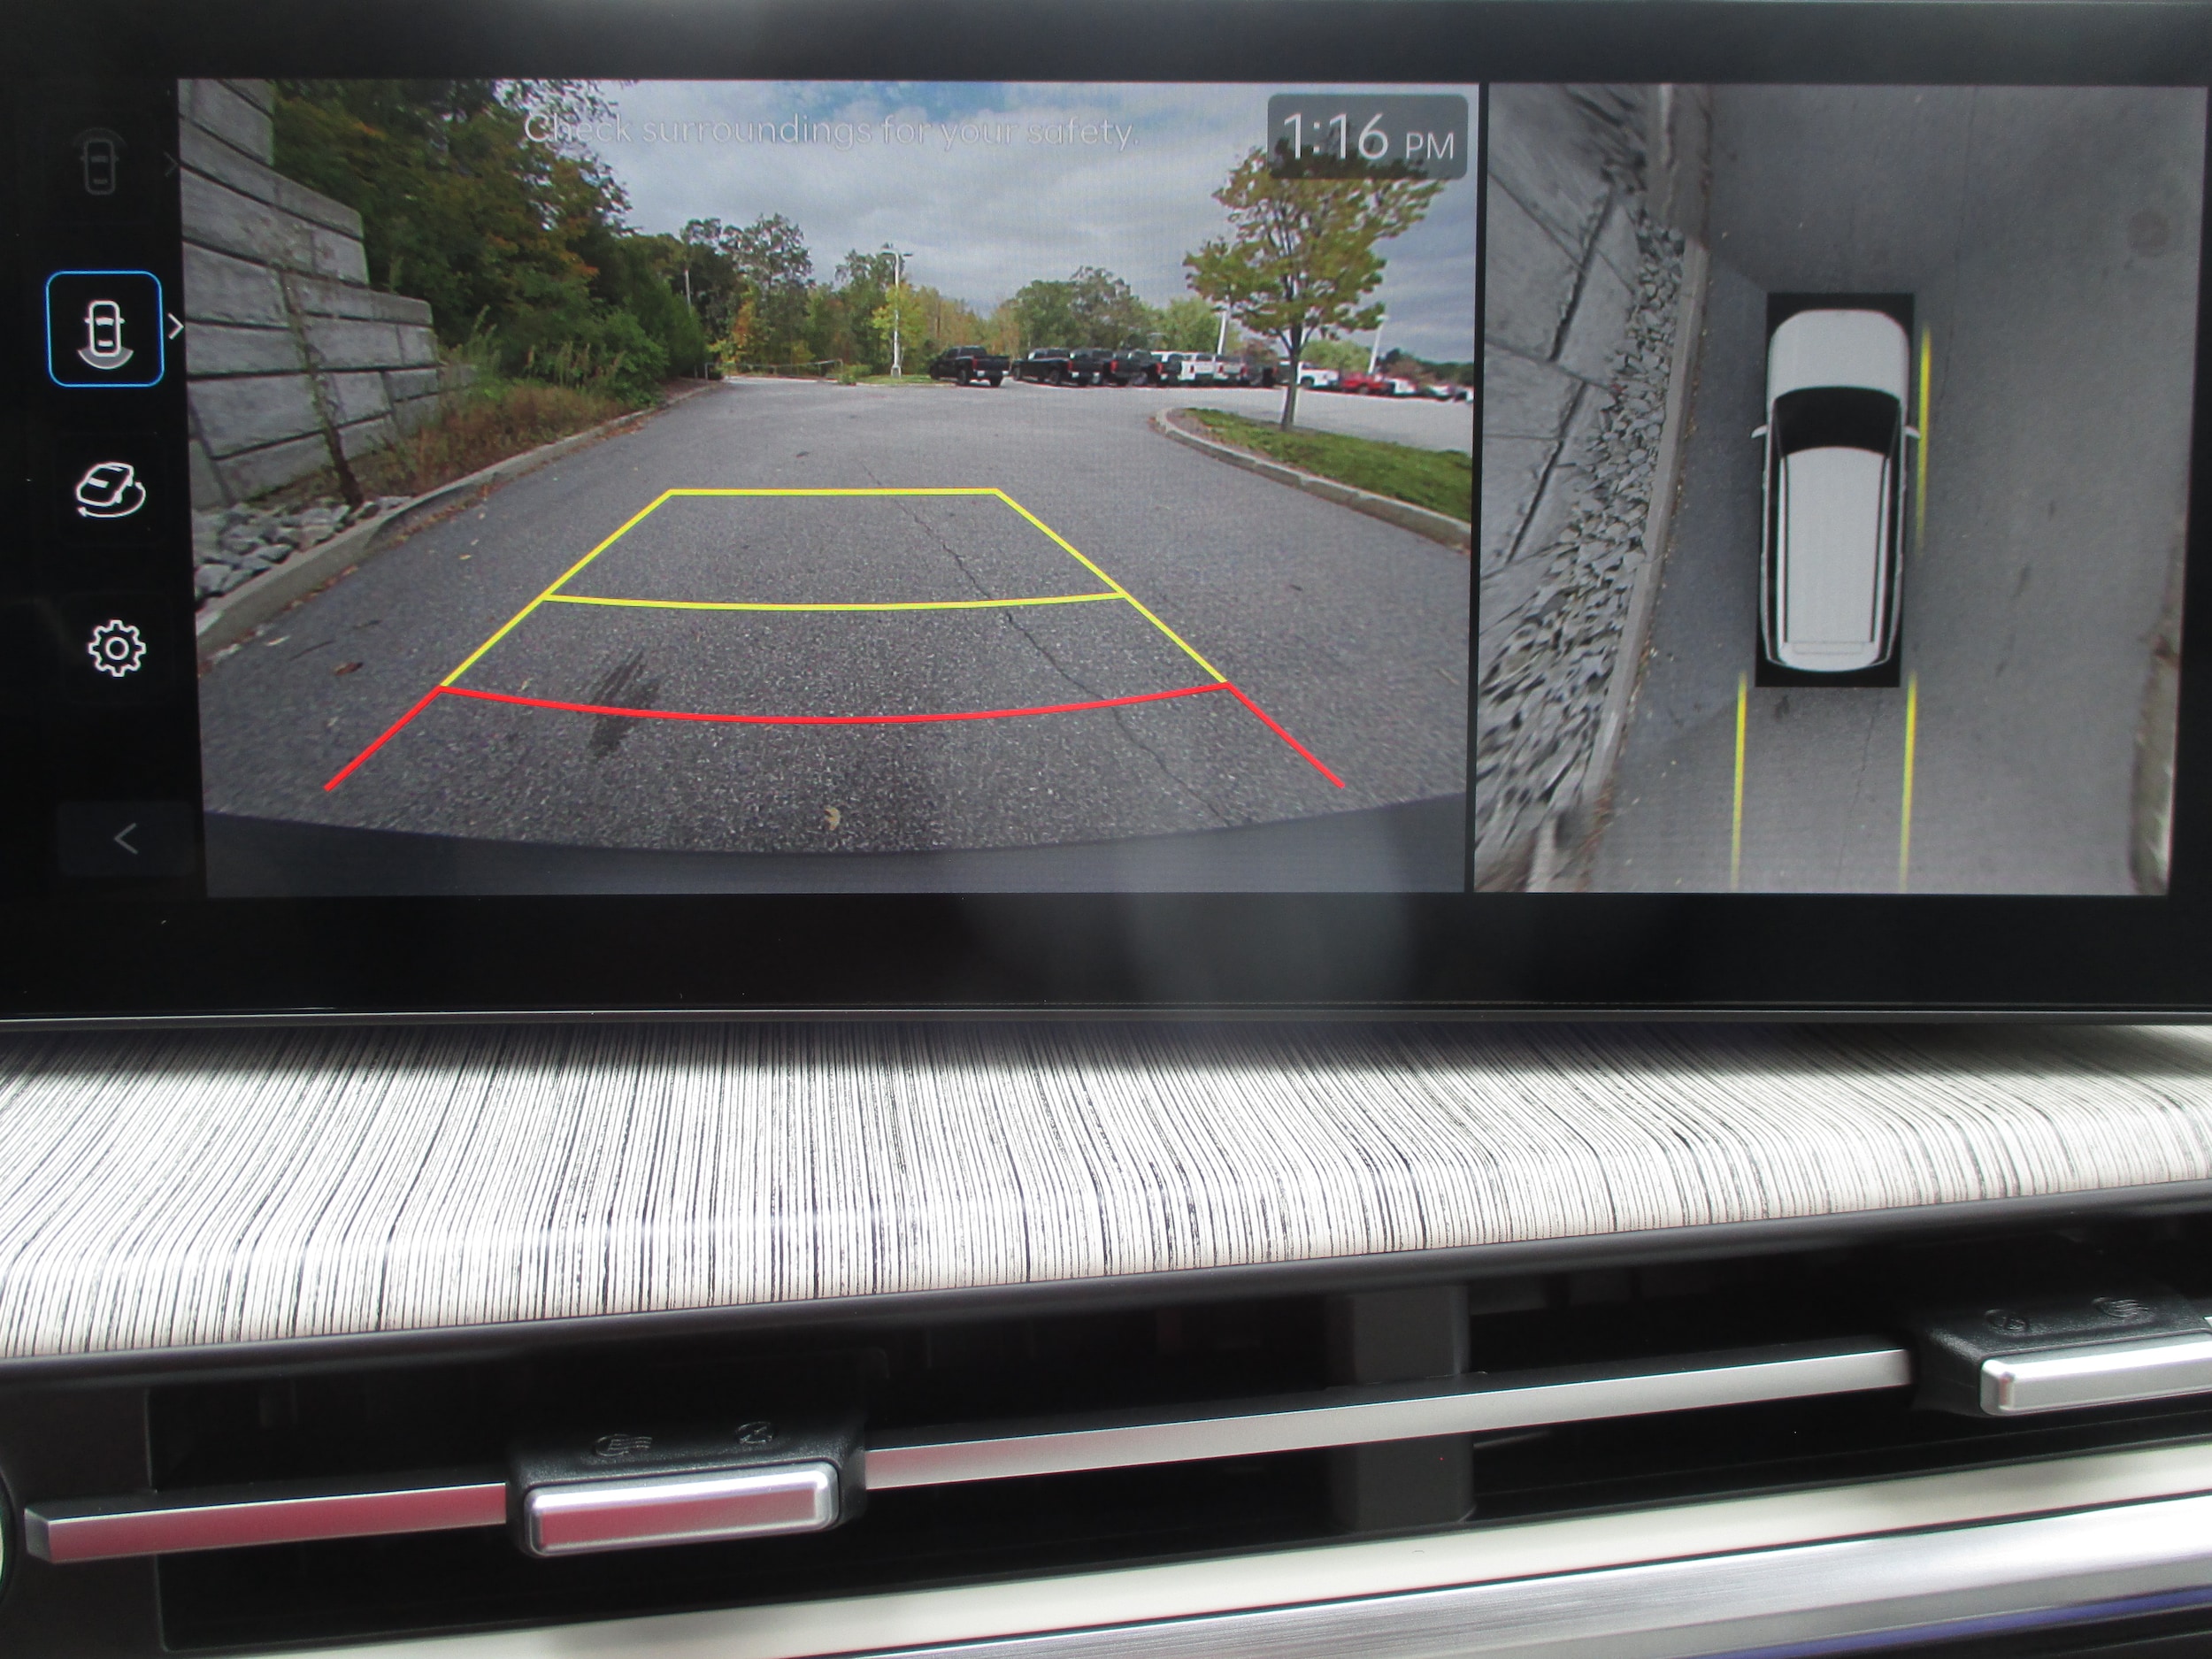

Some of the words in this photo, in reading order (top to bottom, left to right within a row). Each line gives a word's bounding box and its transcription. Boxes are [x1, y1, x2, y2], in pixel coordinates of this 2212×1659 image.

[524, 112, 629, 144] Check
[642, 112, 872, 150] surroundings
[881, 113, 931, 143] for
[940, 121, 1018, 151] your
[1027, 113, 1140, 151] safety.
[1284, 112, 1388, 160] 1:16
[1405, 132, 1454, 159] PM
